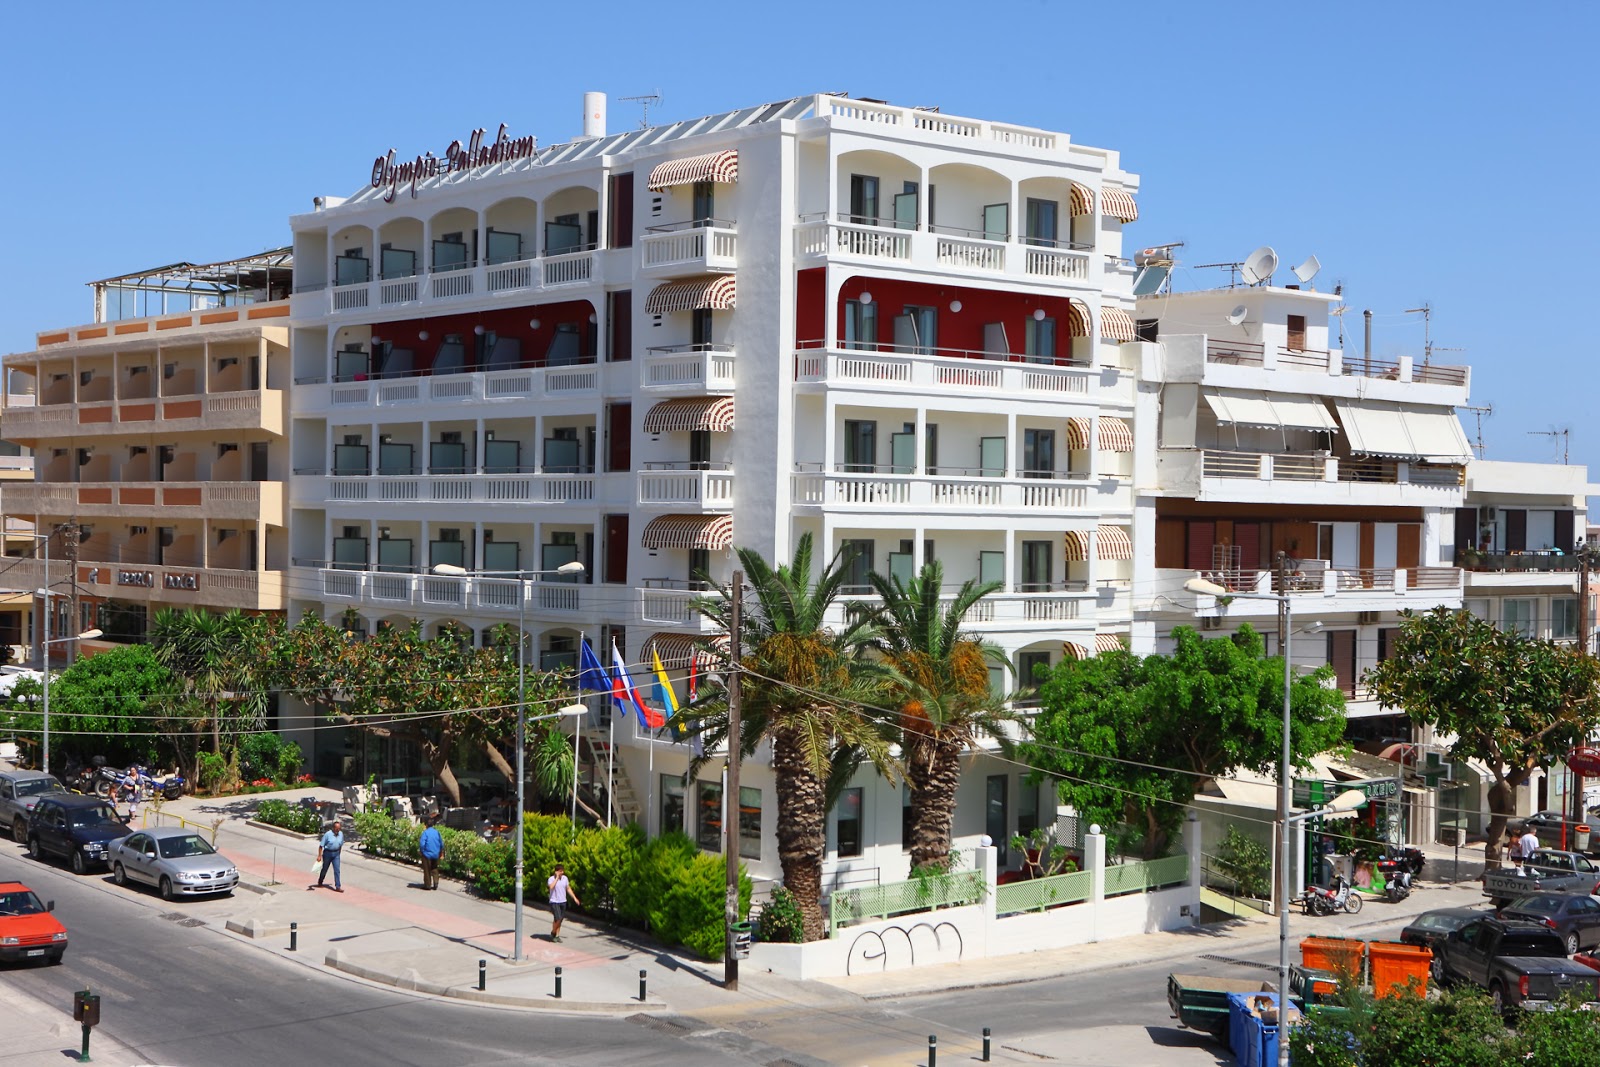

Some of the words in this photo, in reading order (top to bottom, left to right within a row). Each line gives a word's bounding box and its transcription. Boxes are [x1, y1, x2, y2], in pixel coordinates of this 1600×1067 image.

[372, 148, 440, 204] Olympic
[446, 123, 537, 173] Palladium
[1491, 880, 1529, 891] TOYOTA
